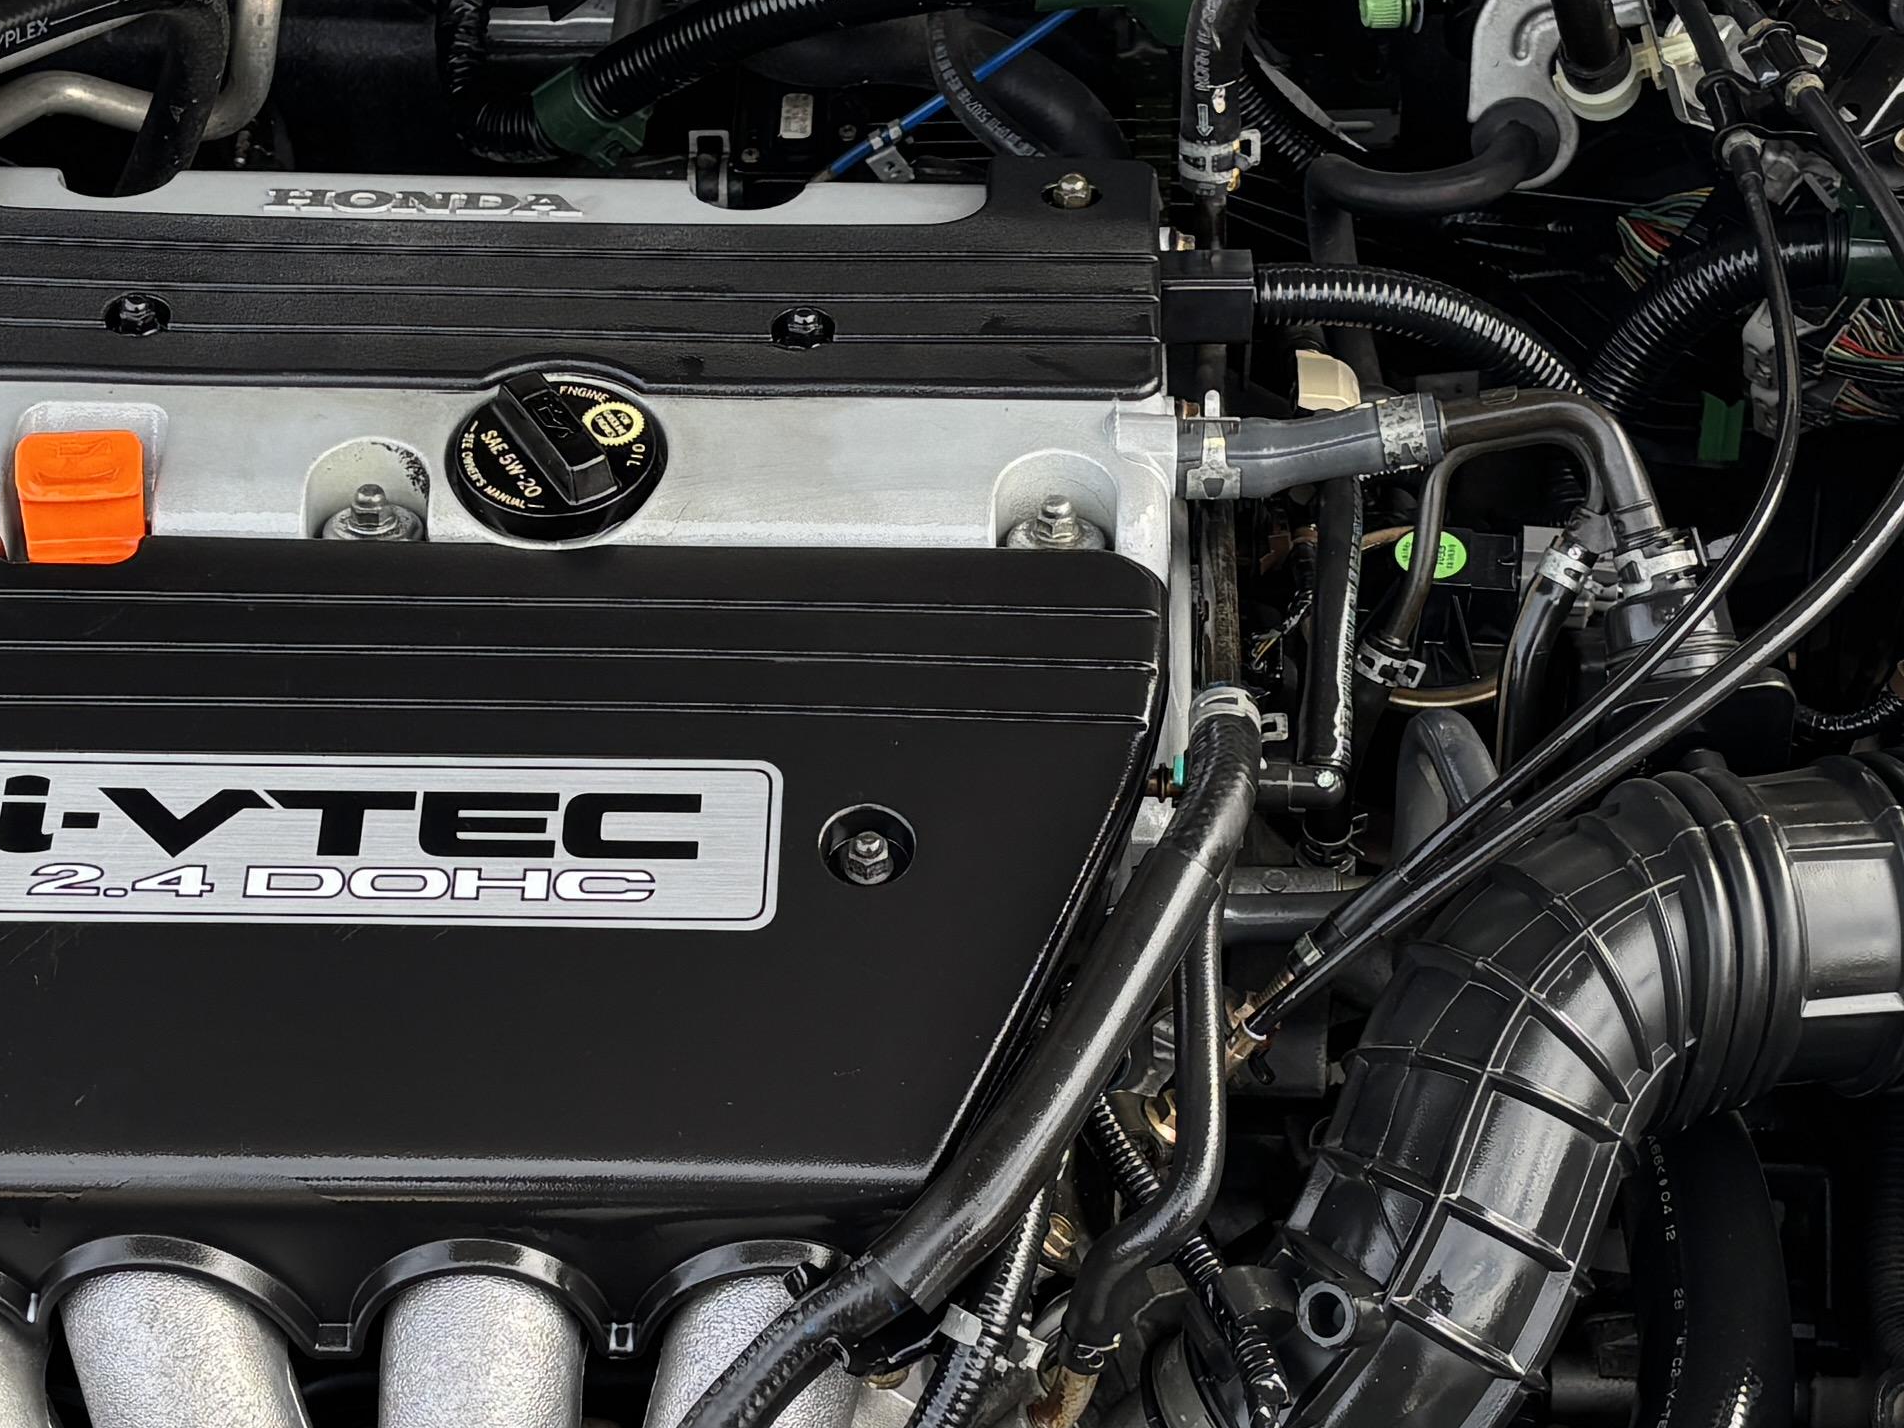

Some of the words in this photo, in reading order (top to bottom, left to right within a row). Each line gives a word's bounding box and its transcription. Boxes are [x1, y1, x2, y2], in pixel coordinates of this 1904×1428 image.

[263, 189, 583, 216] HONDA
[559, 385, 610, 403] ENGINE
[481, 430, 508, 455] SAE
[499, 452, 543, 498] 5W-20
[626, 443, 646, 467] OIL
[484, 485, 526, 509] MANUAL
[26, 862, 214, 899] 2.4
[242, 865, 656, 902] DOHC
